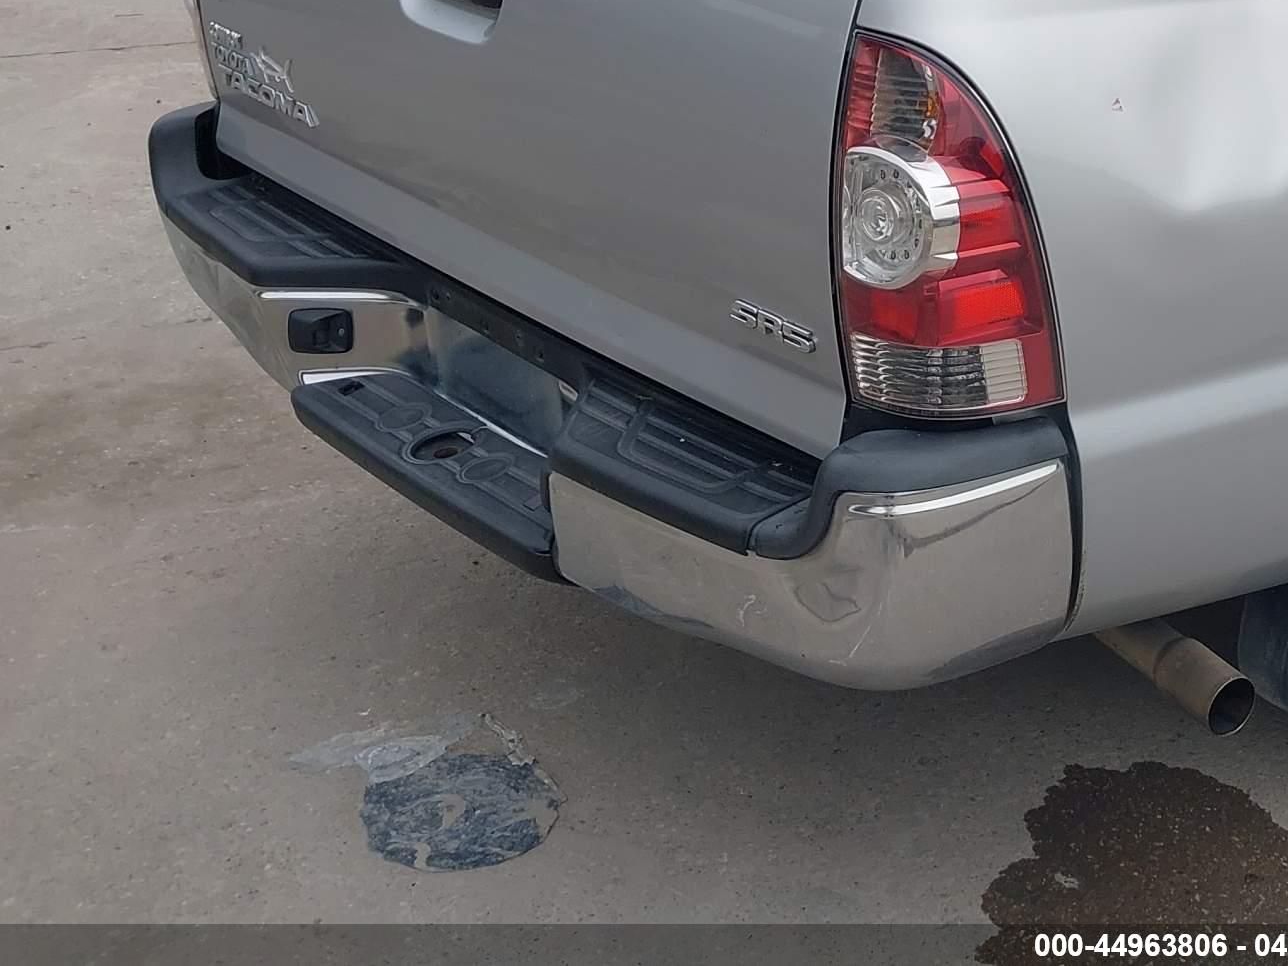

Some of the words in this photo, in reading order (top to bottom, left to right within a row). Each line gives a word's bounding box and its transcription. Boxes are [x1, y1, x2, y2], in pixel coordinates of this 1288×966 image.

[210, 41, 256, 76] TOYOTA
[218, 63, 320, 128] TACOMA
[729, 298, 817, 354] SR5
